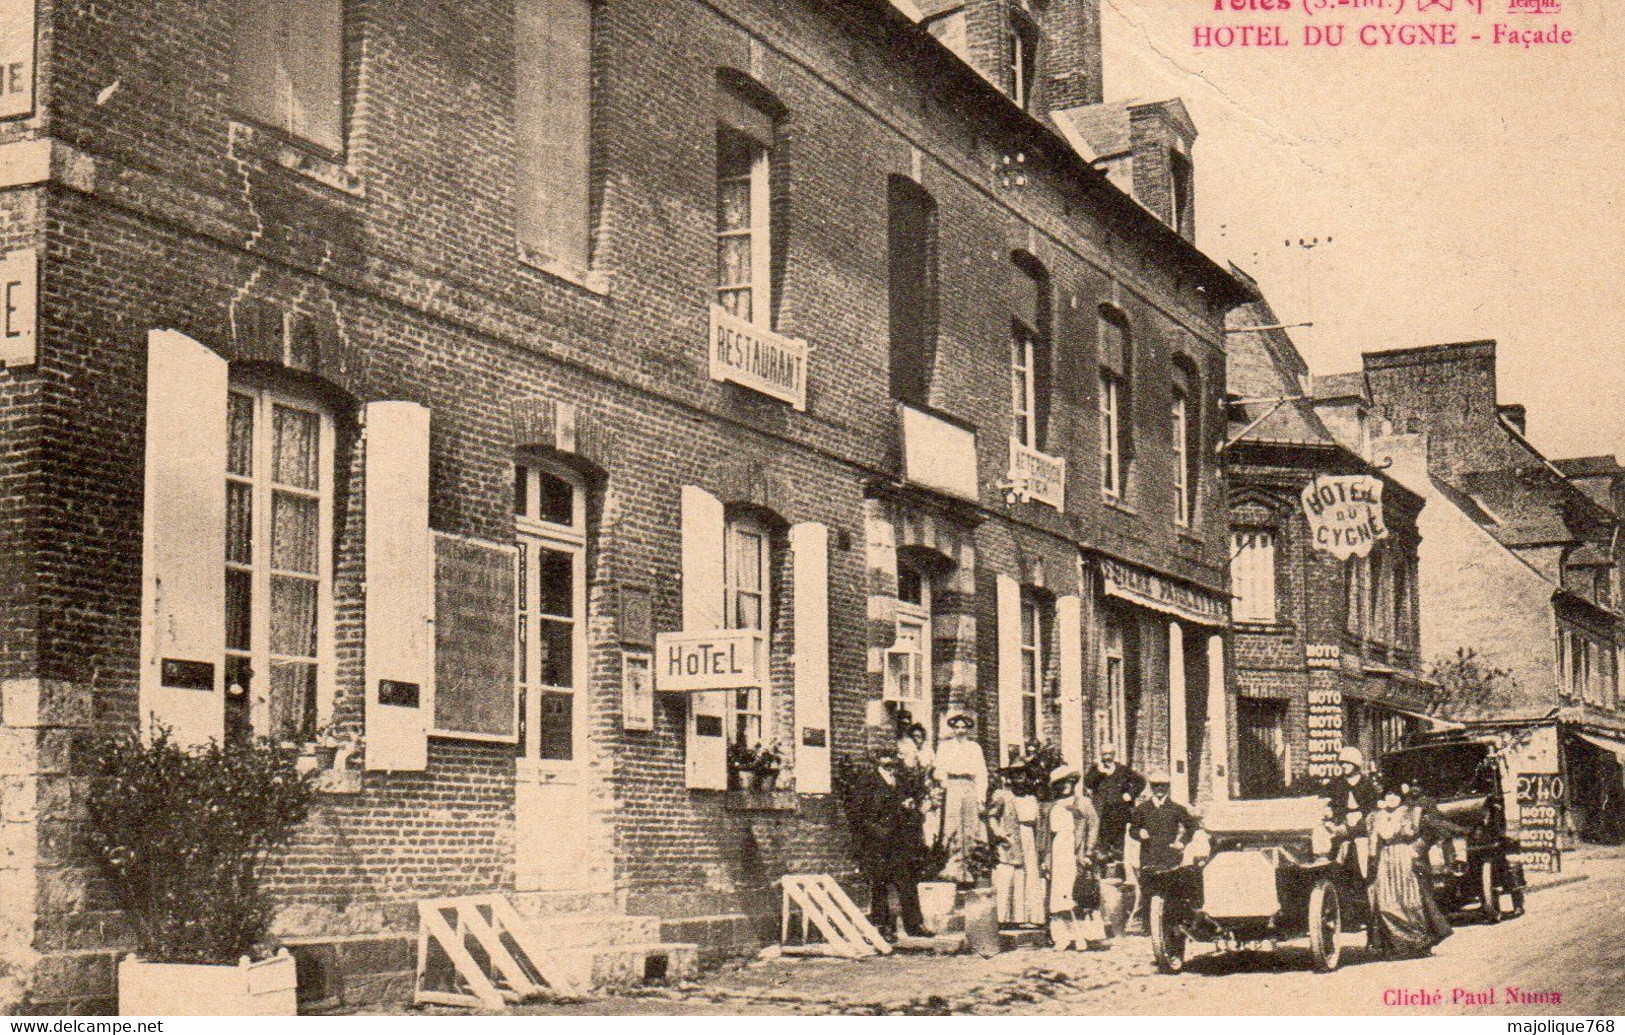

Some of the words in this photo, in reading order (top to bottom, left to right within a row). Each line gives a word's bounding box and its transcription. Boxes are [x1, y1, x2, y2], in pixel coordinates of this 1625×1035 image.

[717, 324, 803, 392] RESTAURANT
[1305, 481, 1378, 516] HOTEL
[1336, 506, 1357, 521] DU
[1316, 504, 1384, 547] CYGNE
